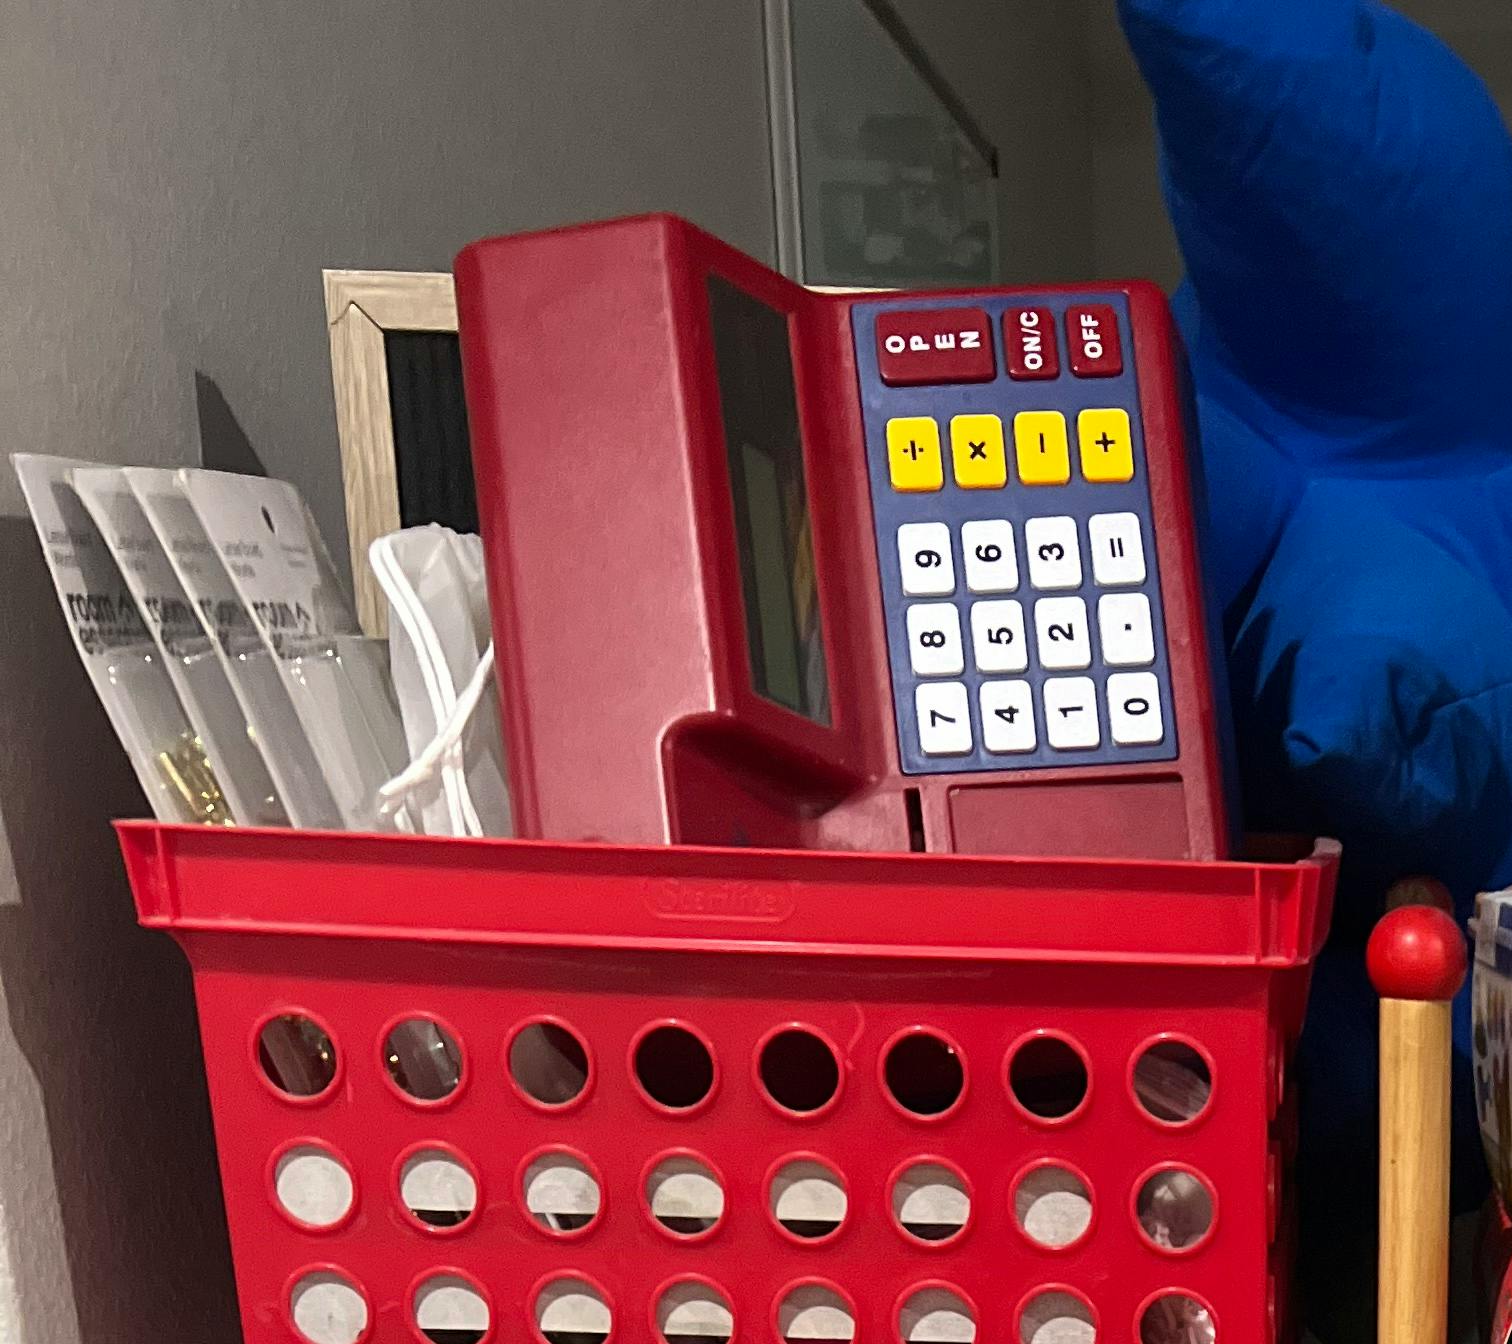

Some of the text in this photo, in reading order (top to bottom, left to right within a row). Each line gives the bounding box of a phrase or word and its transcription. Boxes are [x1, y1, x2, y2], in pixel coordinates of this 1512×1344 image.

[884, 328, 981, 353] OPEN
[1020, 310, 1043, 371] ON/C
[1080, 312, 1103, 360] OFF
[1039, 542, 1064, 561] 3
[921, 623, 1073, 649] 8 5 2
[930, 698, 1149, 727] 7 4 1 0
